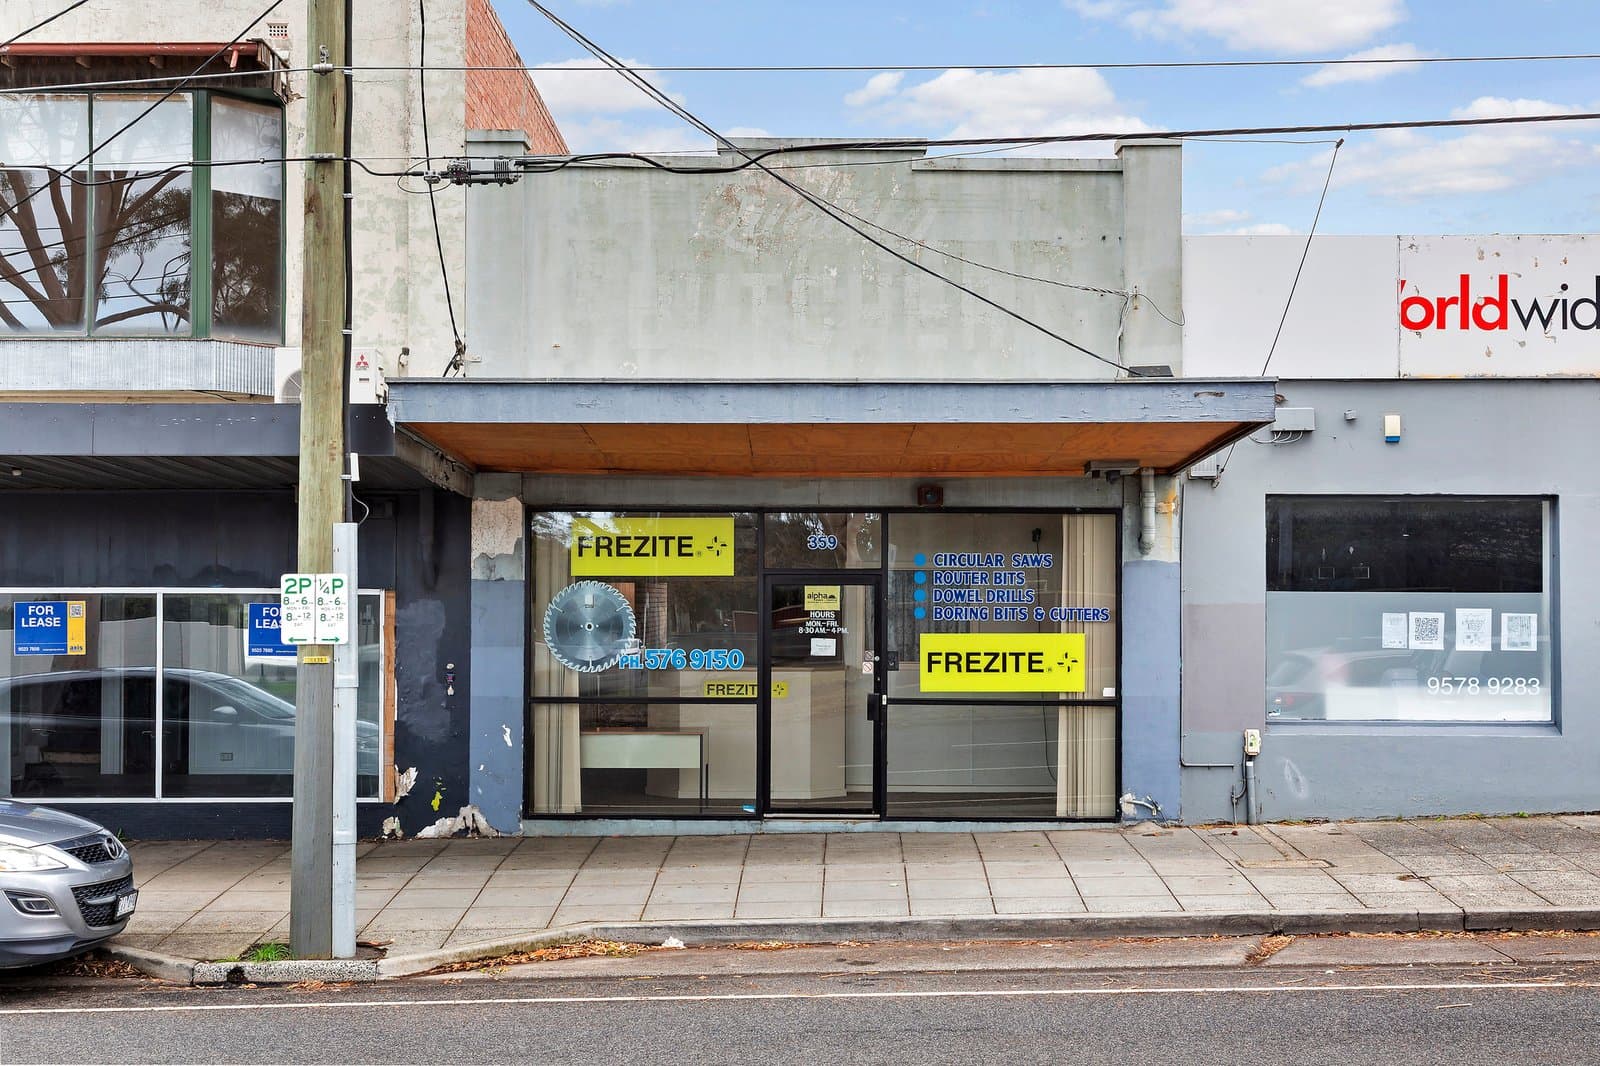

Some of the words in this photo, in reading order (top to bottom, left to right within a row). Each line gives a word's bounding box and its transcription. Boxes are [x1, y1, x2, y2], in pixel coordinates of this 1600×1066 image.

[1400, 274, 1600, 331] orldwid
[577, 536, 694, 557] FREZITE
[807, 535, 838, 550] 359
[933, 552, 1004, 568] CIRCULAR
[1012, 553, 1053, 568] SAWS
[284, 578, 312, 594] 2P
[932, 571, 990, 586] ROUTER
[994, 571, 1026, 586] BITS
[806, 592, 828, 601] alpha
[932, 588, 983, 604] DOWEL
[986, 588, 1035, 604] DRILLS
[28, 605, 54, 616] FOR
[262, 607, 281, 616] FO
[932, 606, 988, 621] BORING
[993, 606, 1028, 621] BITS
[1033, 607, 1045, 621] &
[1049, 607, 1110, 622] CUTTERS
[21, 617, 61, 628] LEASE
[255, 618, 281, 629] LEA
[645, 649, 686, 670] 576
[689, 649, 744, 669] 9150
[927, 652, 1044, 673] FREZITE
[707, 684, 758, 696] FREZIT
[1427, 677, 1480, 696] 9578
[1488, 677, 1540, 696] 9283
